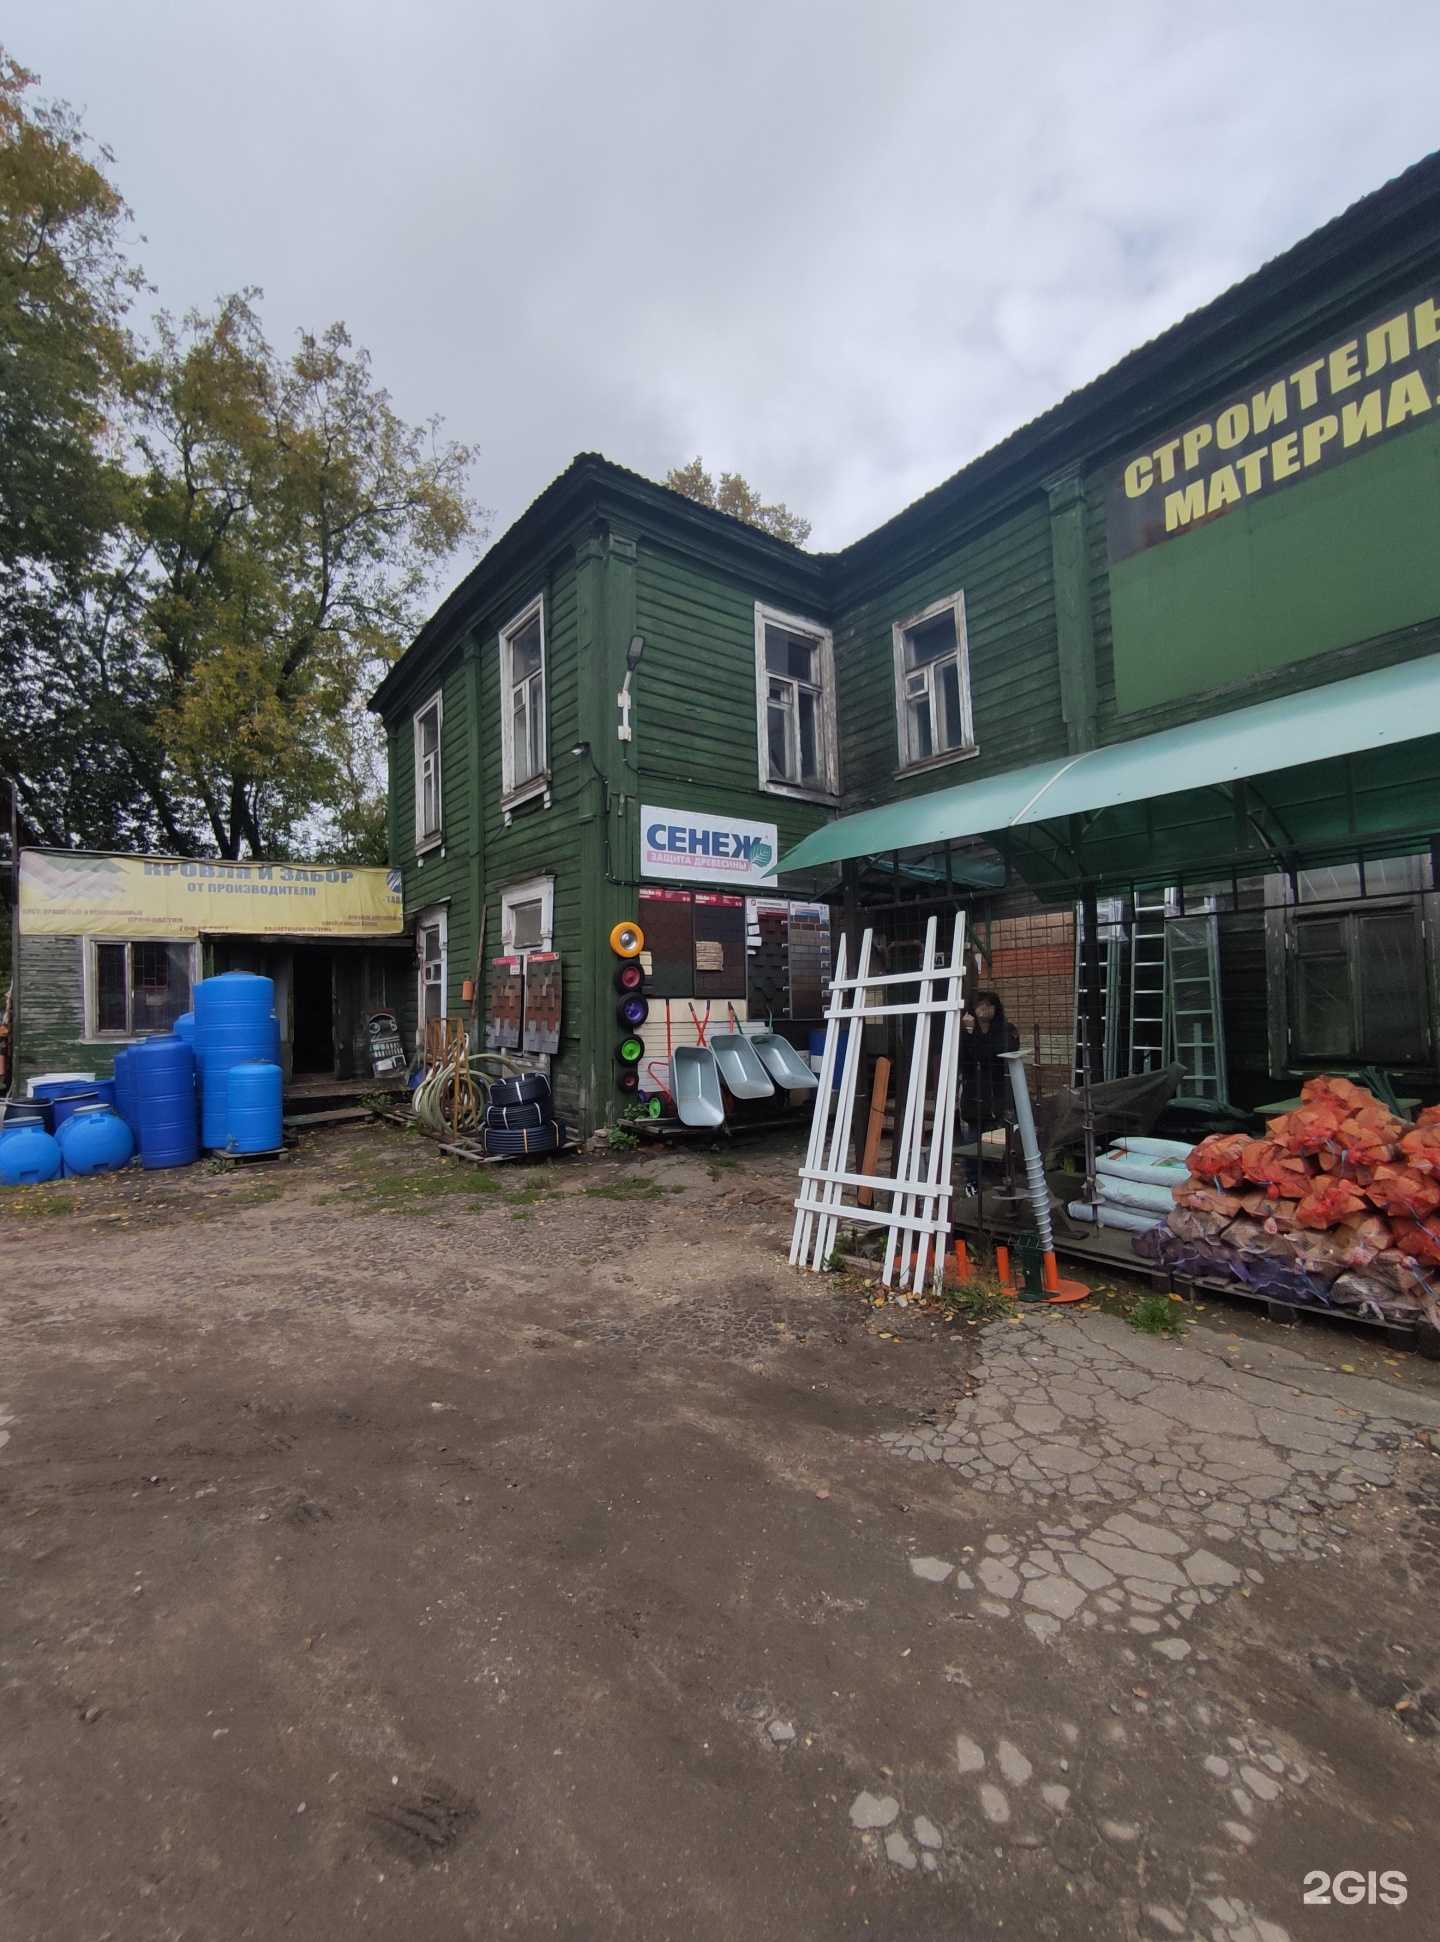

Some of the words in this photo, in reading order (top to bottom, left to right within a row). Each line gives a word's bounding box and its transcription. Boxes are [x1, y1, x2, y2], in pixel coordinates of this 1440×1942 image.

[1164, 369, 1440, 532] МАТЕРИА
[647, 824, 762, 860] СЕНЕЖ
[650, 852, 690, 865] ЗАЩИТА
[694, 856, 748, 872] ДРЕВЕСИНЫ
[258, 866, 273, 880] И
[187, 882, 204, 893] ОТ
[207, 883, 316, 896] ПРОИЗВОДИТЕЛЯ
